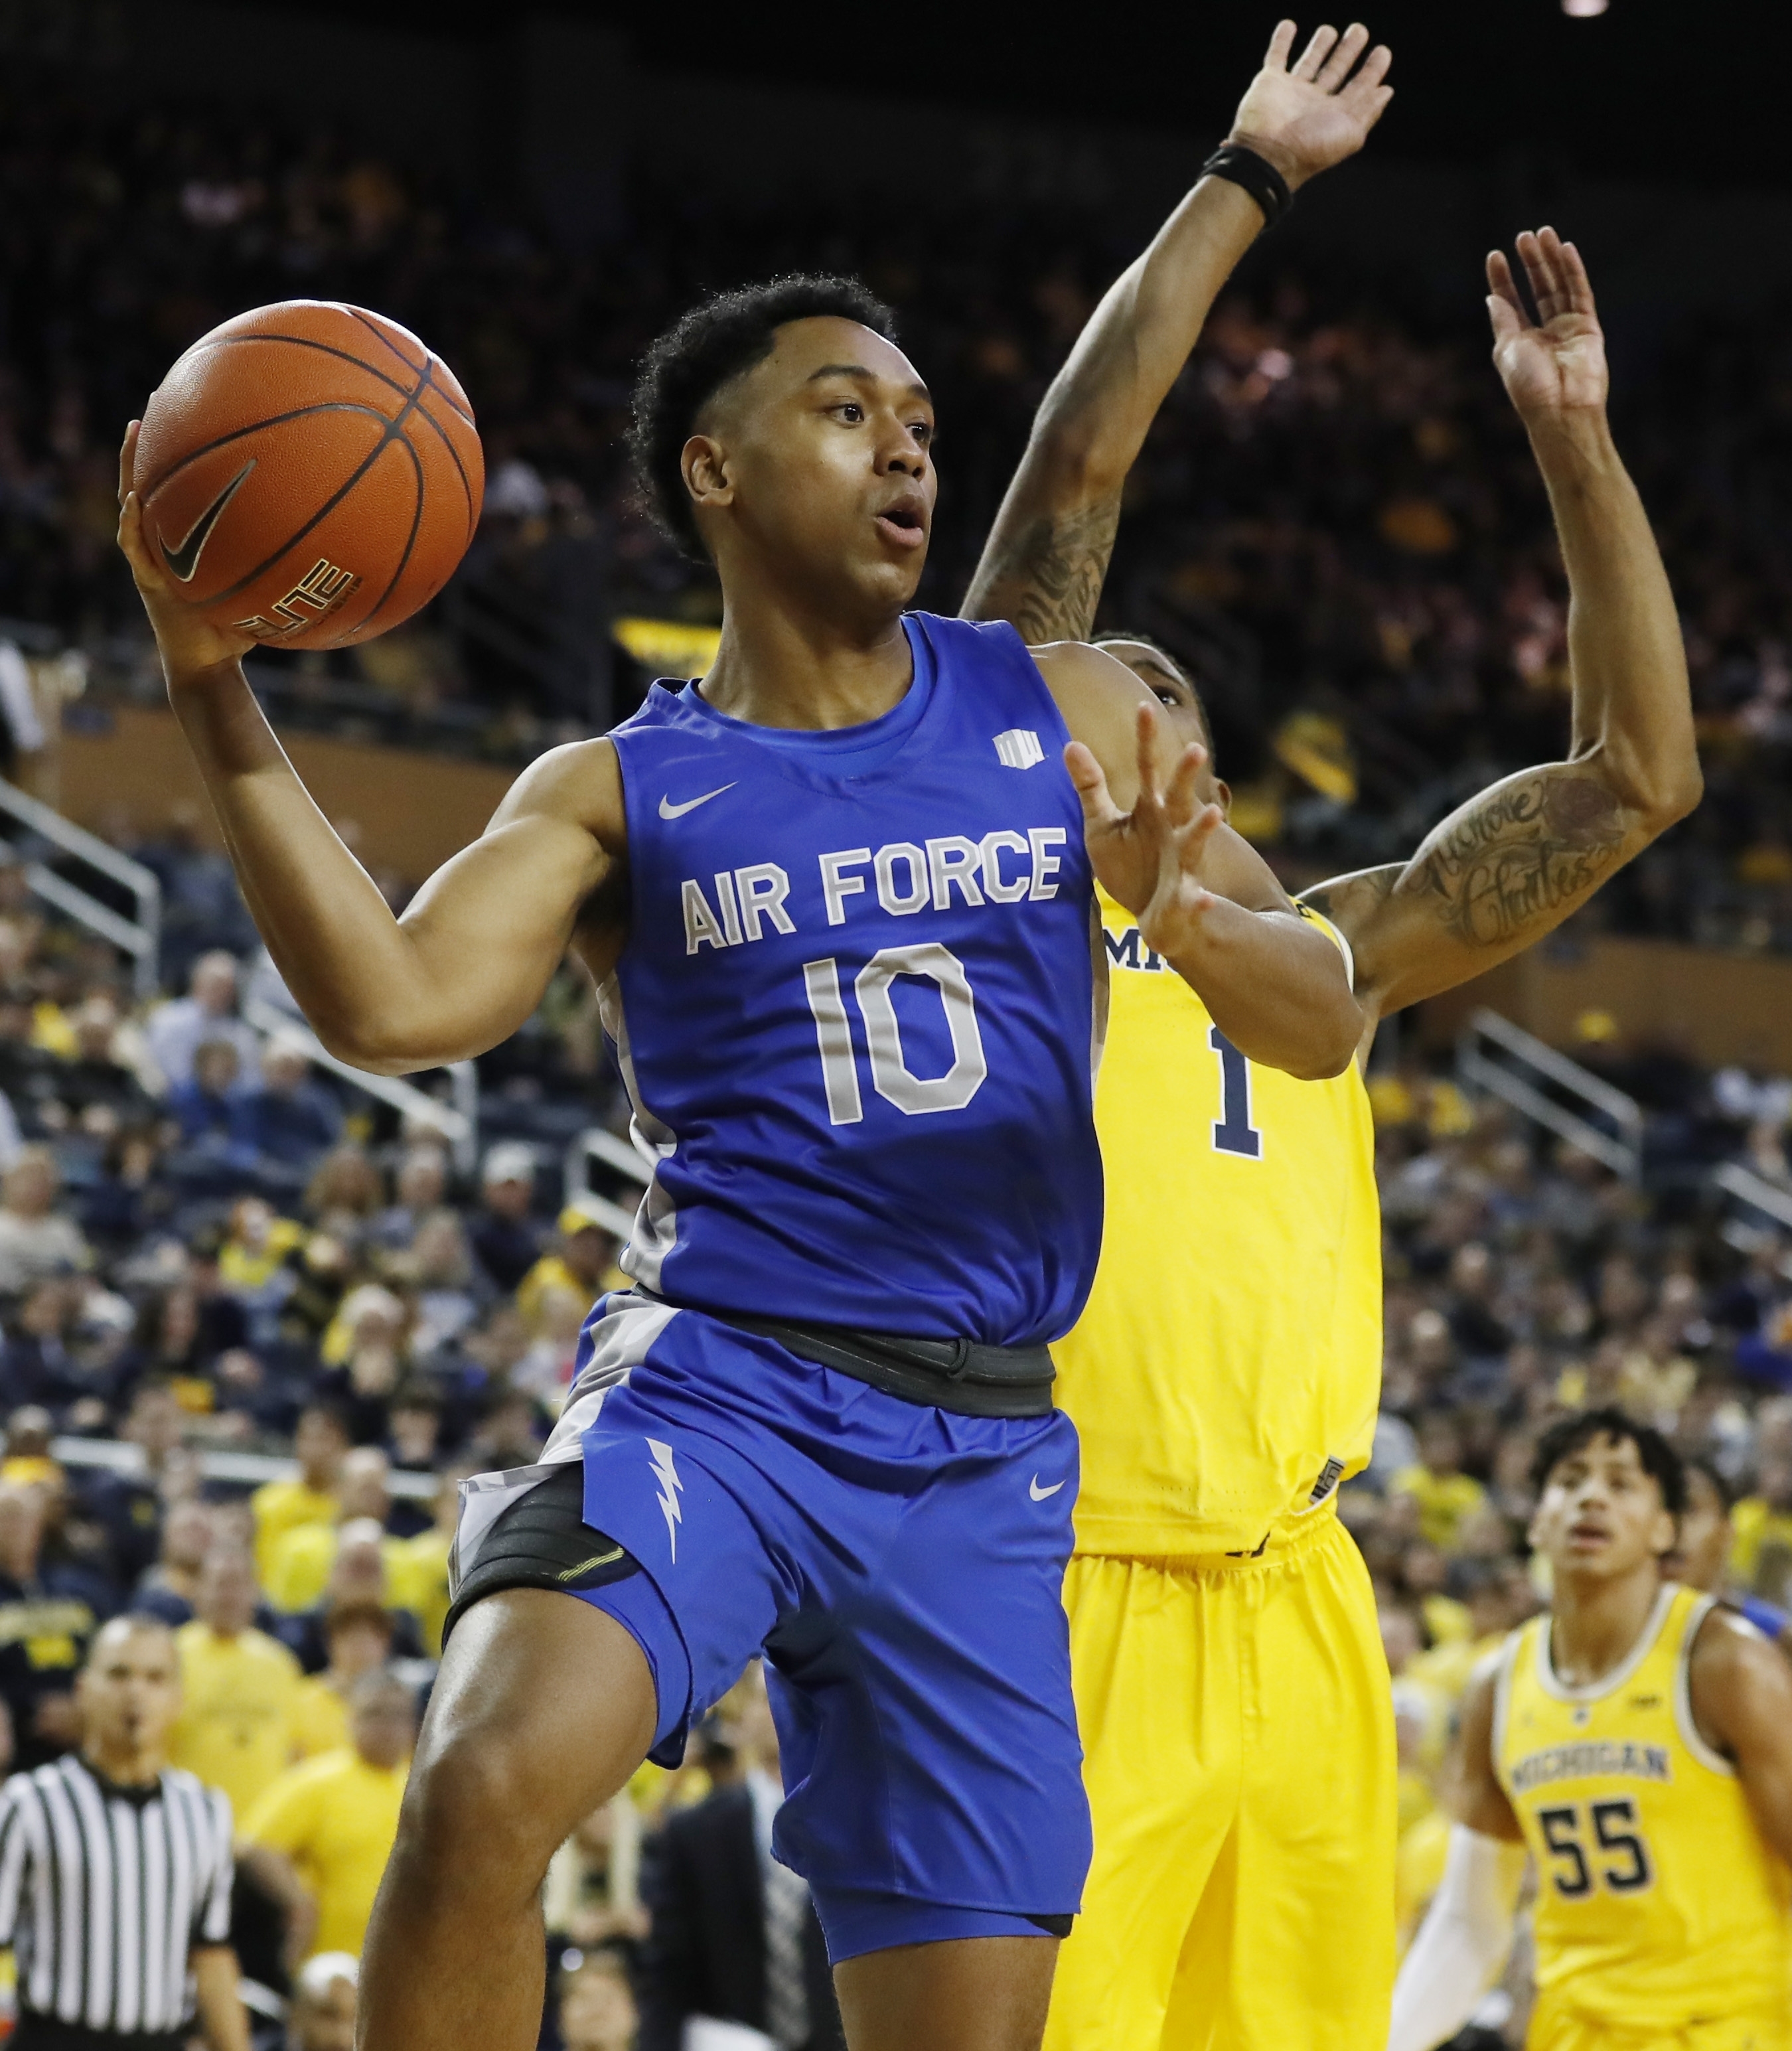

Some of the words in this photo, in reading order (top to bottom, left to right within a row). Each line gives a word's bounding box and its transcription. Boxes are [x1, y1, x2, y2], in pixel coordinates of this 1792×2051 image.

[681, 862, 797, 955] AIR
[818, 827, 1067, 926] FORCE
[802, 942, 988, 1126] 10
[1206, 1022, 1262, 1162] 1
[1534, 1796, 1653, 1902] 55
